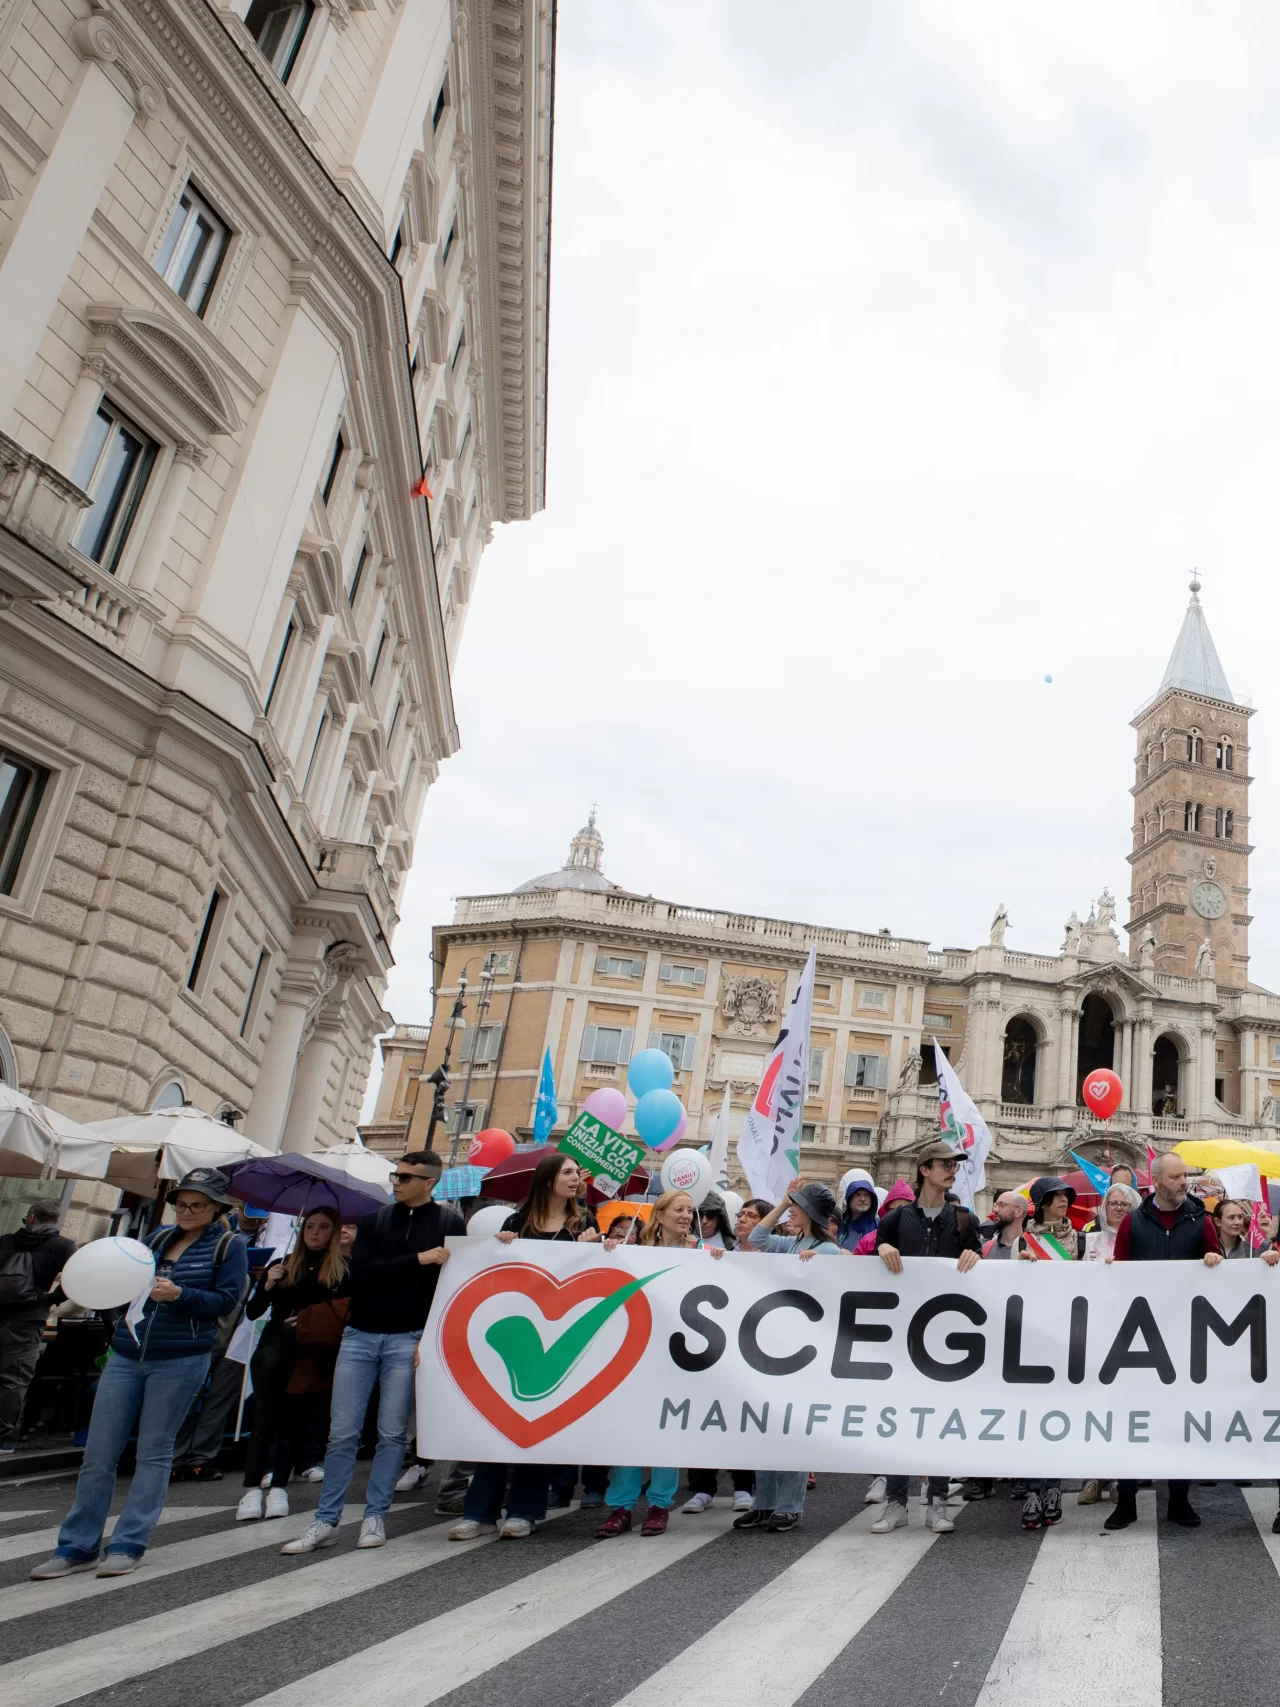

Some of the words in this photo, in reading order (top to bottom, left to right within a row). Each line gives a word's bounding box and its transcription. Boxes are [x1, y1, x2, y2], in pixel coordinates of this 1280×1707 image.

[566, 1136, 625, 1179] CONCEPIMENTO
[571, 1126, 605, 1157] INIZIA
[606, 1151, 630, 1173] COL
[577, 1115, 600, 1138] LA
[603, 1131, 639, 1164] VITA
[672, 1171, 697, 1184] FAMILY
[679, 1177, 693, 1187] DAY
[659, 1397, 1151, 1443] MANIFESTAZIONE
